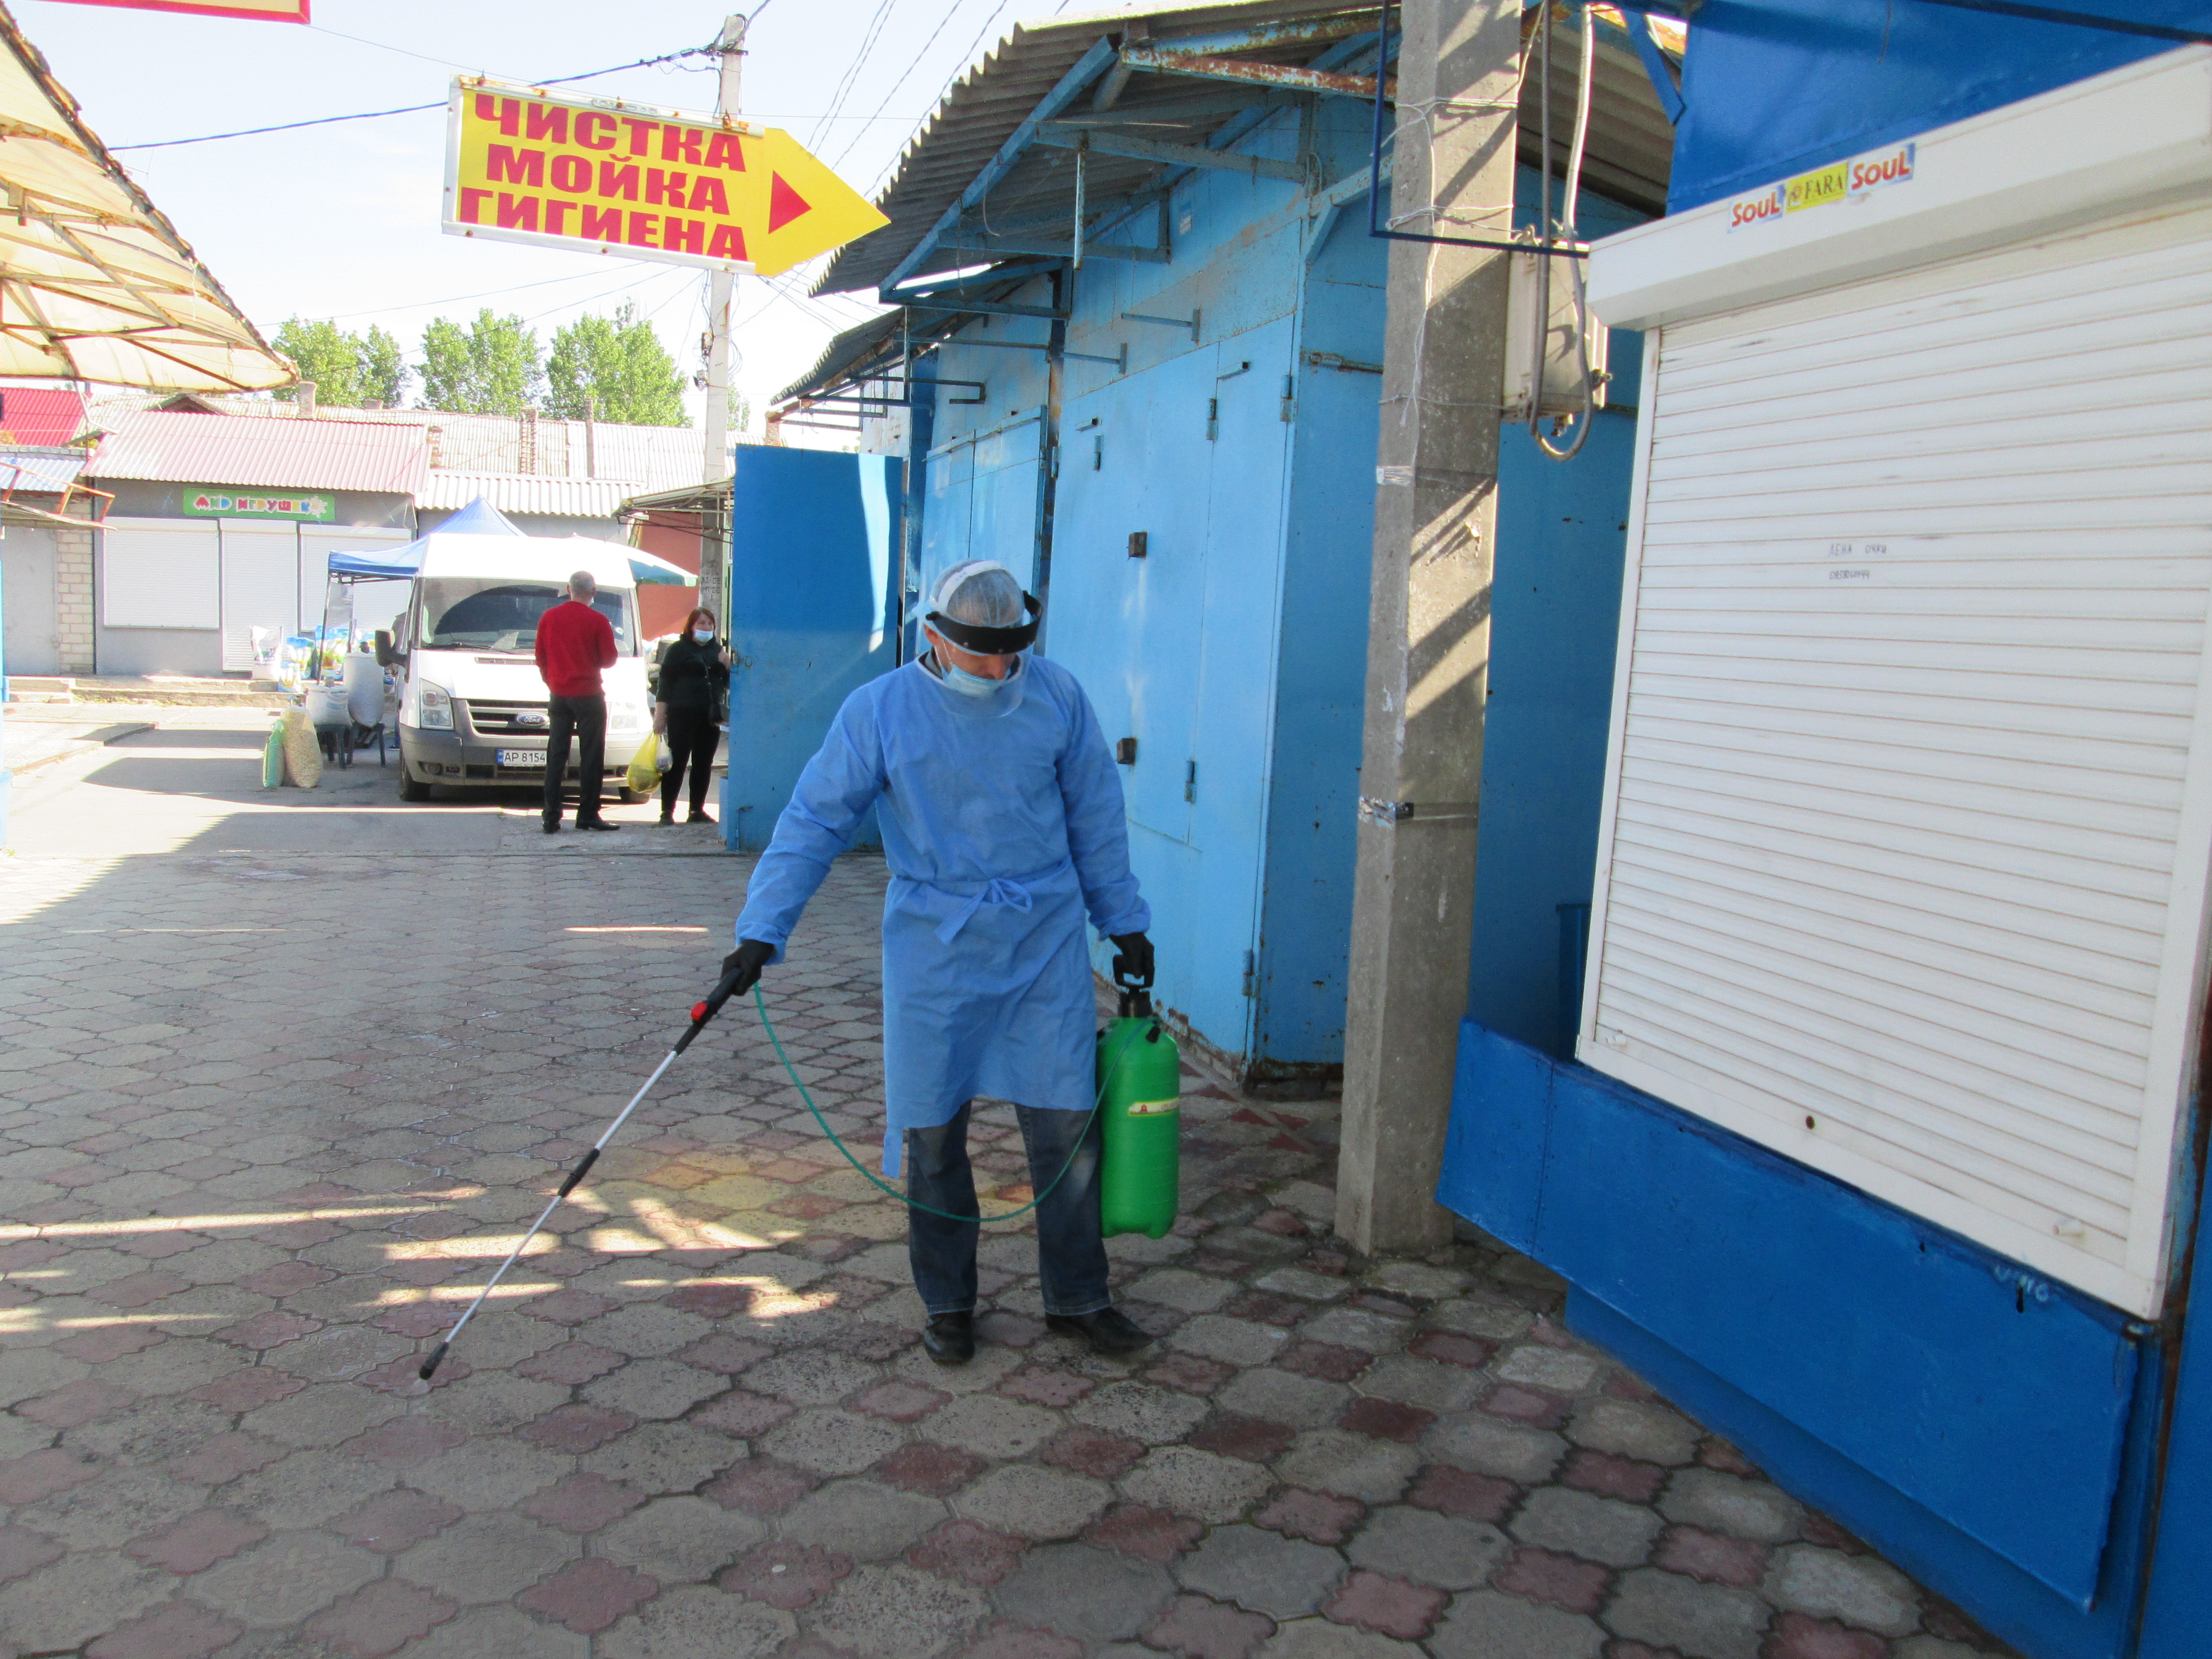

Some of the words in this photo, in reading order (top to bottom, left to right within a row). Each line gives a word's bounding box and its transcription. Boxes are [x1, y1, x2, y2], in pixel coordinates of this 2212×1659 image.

[474, 93, 746, 172] ЧИСТКА
[486, 144, 730, 216] МОЙКА
[1731, 191, 1781, 228] SOUL
[1804, 173, 1844, 199] FARA
[1851, 150, 1911, 191] SOUL
[459, 187, 748, 261] ГИГИЕНА
[523, 715, 542, 723] Ford
[504, 752, 519, 762] AP
[522, 753, 545, 762] 8154
